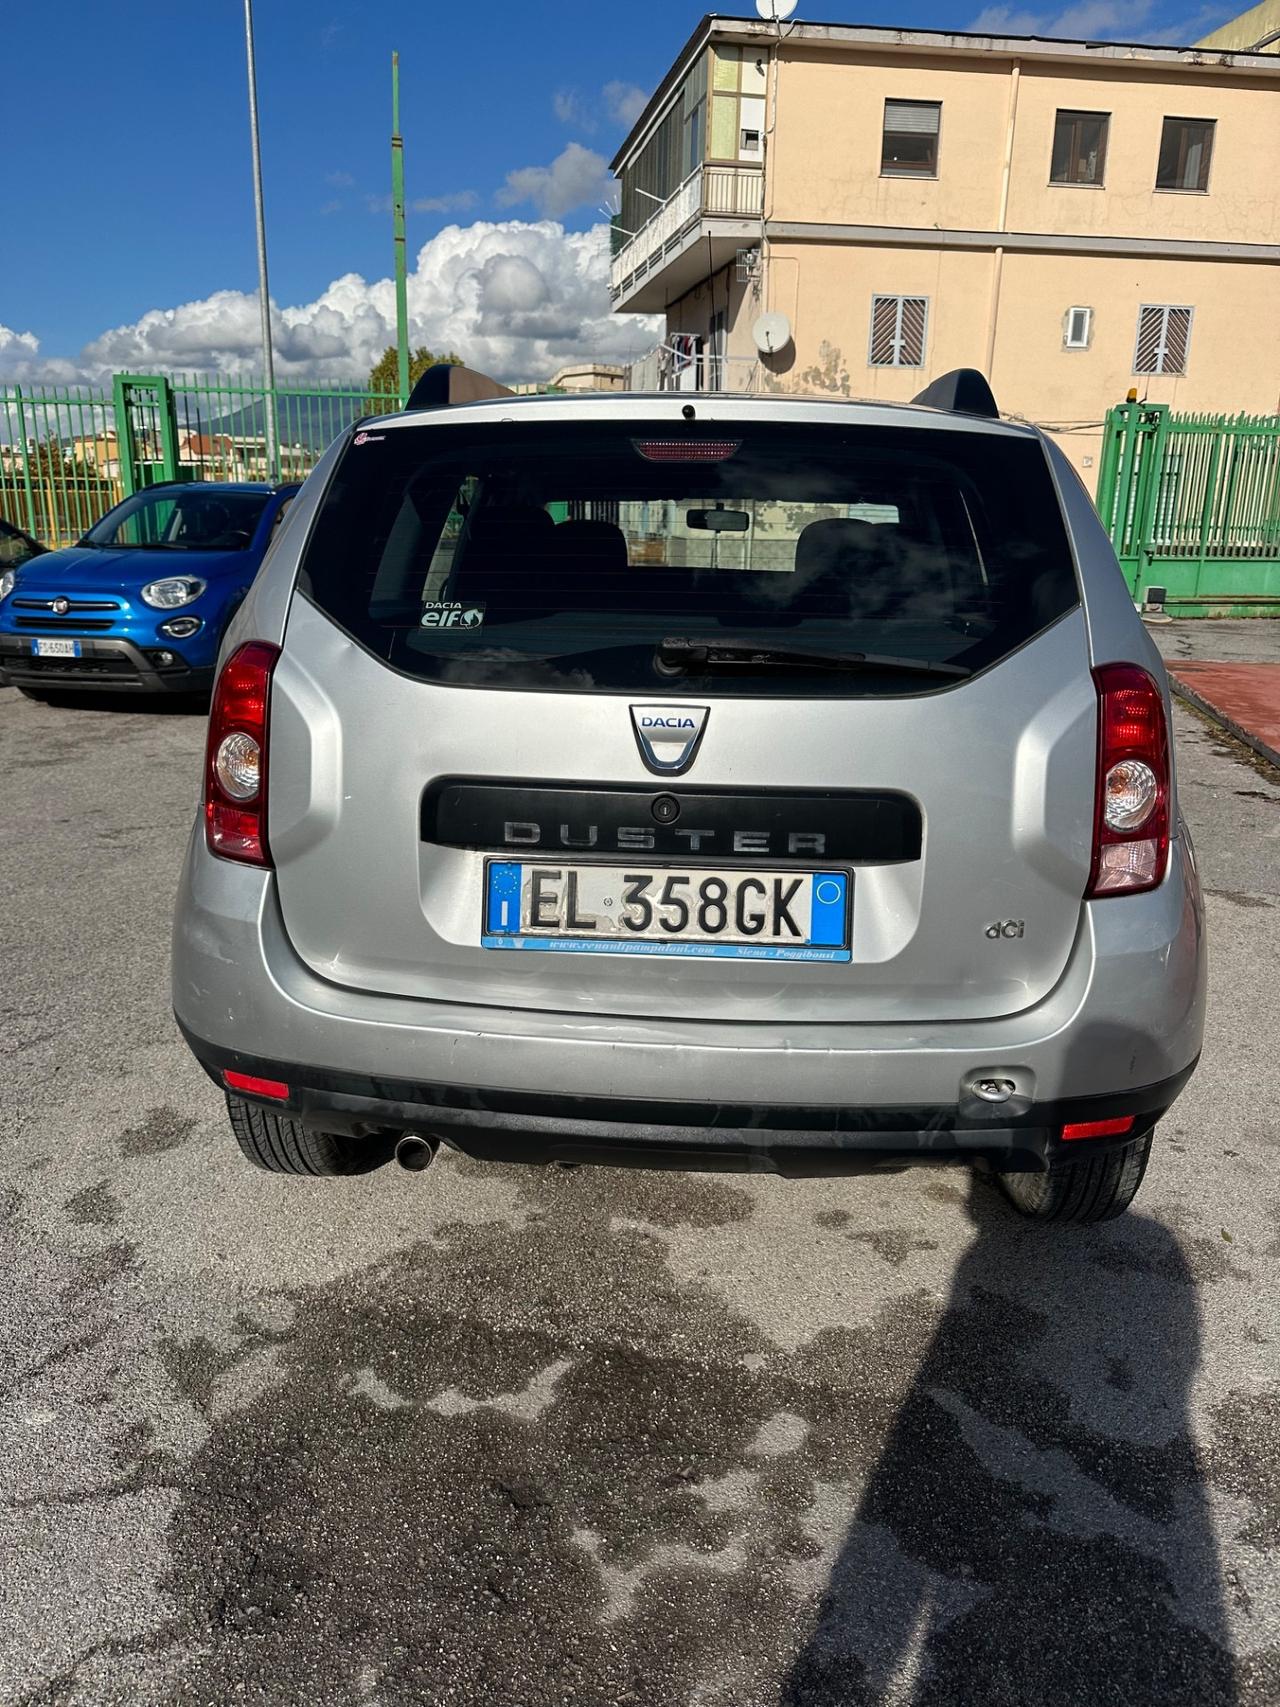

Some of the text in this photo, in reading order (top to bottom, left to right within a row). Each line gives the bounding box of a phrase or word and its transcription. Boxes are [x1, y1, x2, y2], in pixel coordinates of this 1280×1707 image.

[421, 610, 462, 627] elf
[641, 717, 695, 728] DACIA
[504, 821, 825, 853] DUSTER
[530, 870, 805, 937] EL 358GK
[985, 919, 1025, 939] dCi
[736, 945, 767, 956] Siena
